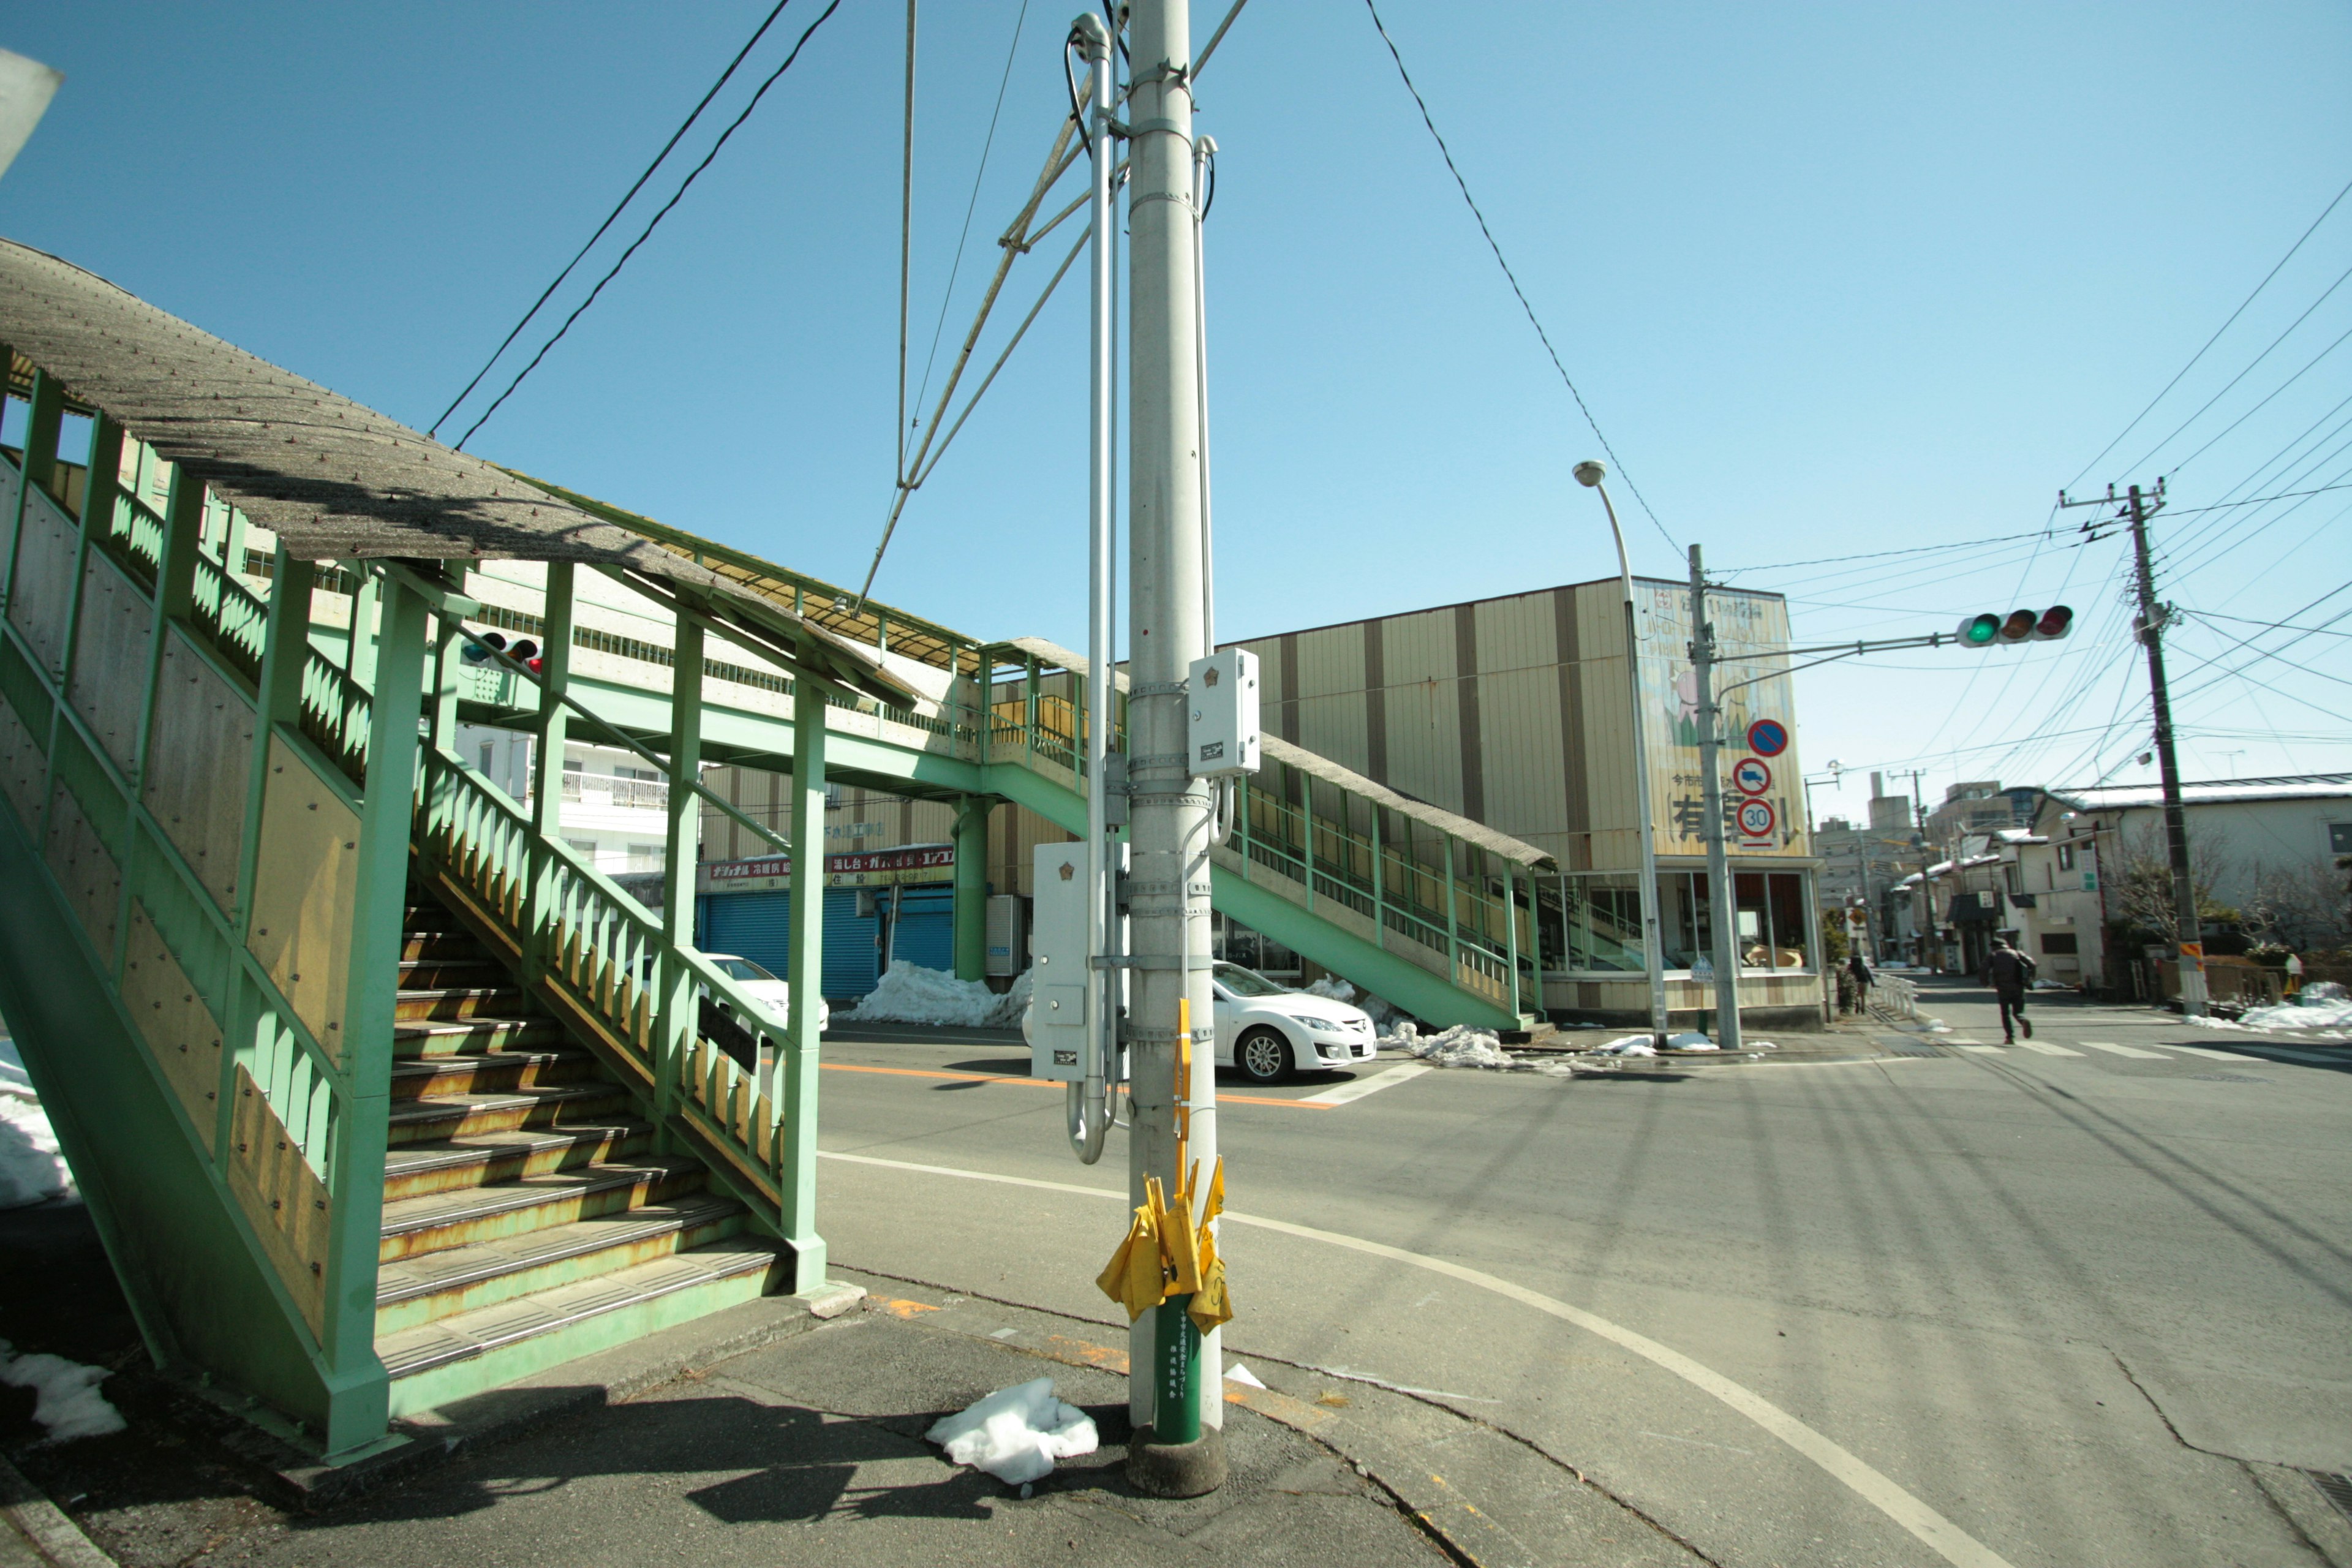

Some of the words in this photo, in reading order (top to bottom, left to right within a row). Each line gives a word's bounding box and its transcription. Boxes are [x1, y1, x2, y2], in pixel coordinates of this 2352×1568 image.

[1746, 809, 1767, 827] 30
[714, 864, 749, 877] ナショナル
[753, 862, 779, 874] 冷暖房
